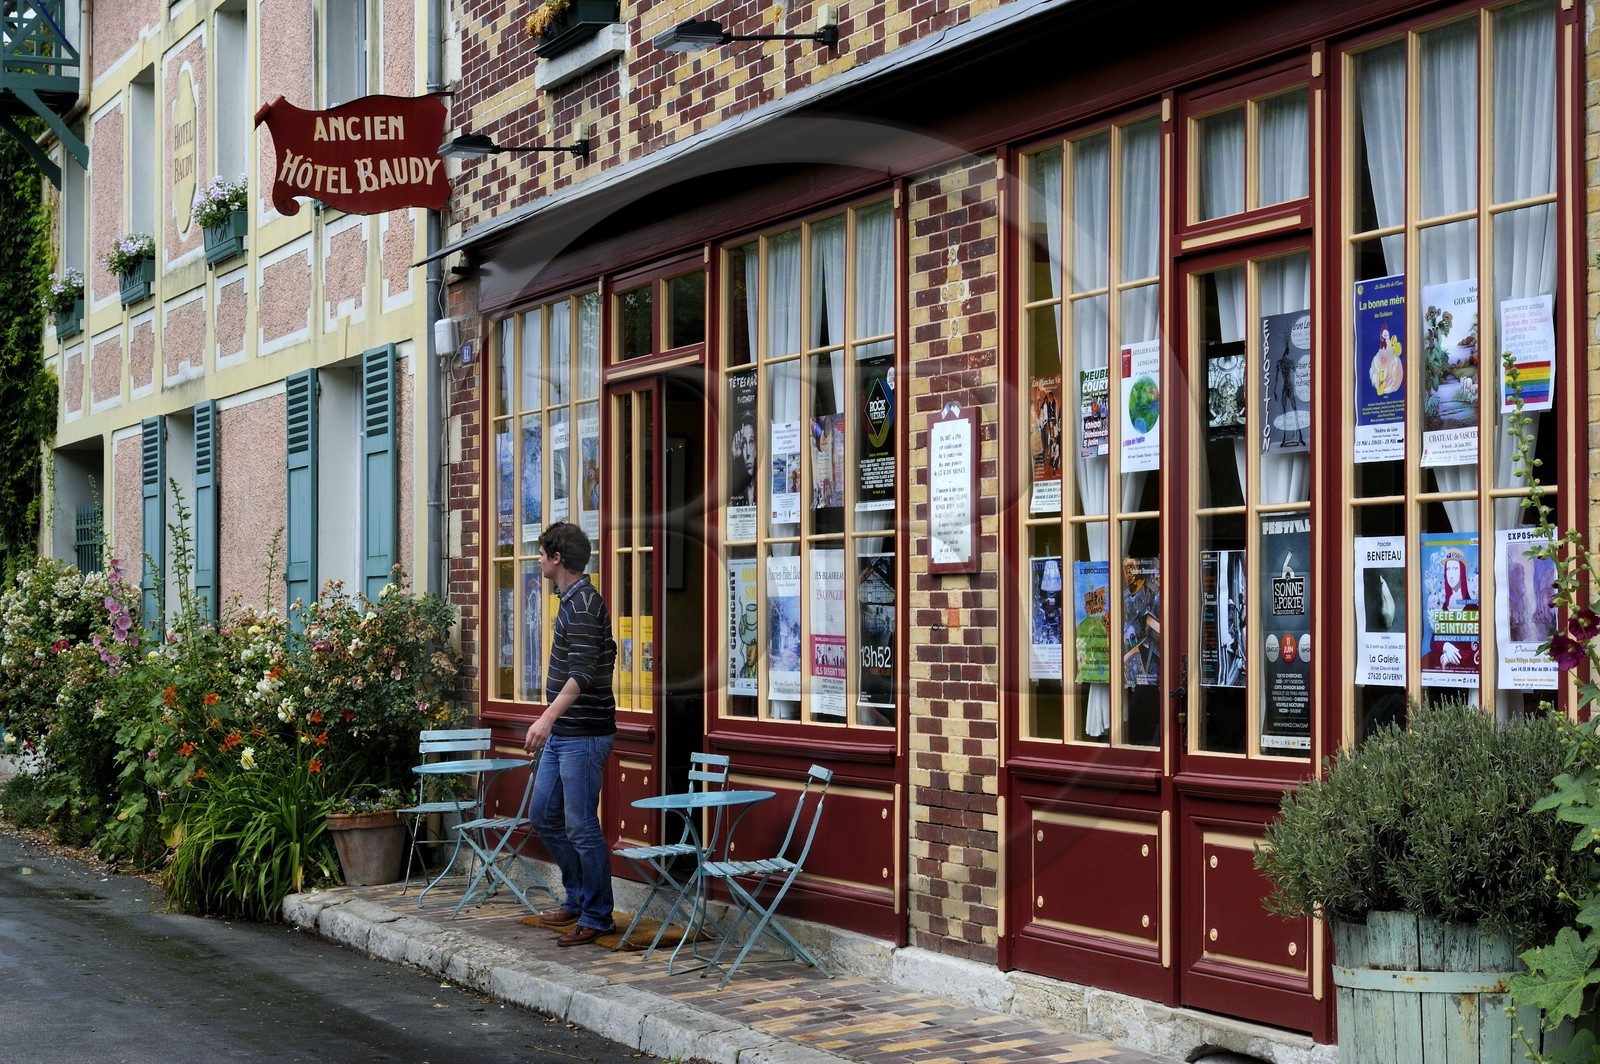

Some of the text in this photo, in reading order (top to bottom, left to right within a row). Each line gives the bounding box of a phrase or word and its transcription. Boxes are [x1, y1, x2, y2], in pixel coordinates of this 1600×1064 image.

[313, 115, 405, 142] ANCIEN
[278, 148, 442, 194] HÔTEL BAUDY
[1359, 302, 1367, 310] La
[1368, 299, 1388, 309] bonne
[870, 400, 885, 411] ROCK
[1263, 519, 1310, 535] FESTIVAL
[1367, 551, 1402, 561] BENETEAU
[1275, 582, 1303, 597] SONNE
[1434, 609, 1453, 621] FÊTE
[1456, 611, 1467, 620] DE
[1434, 622, 1478, 634] PEINTURE
[1367, 672, 1381, 680] 27620
